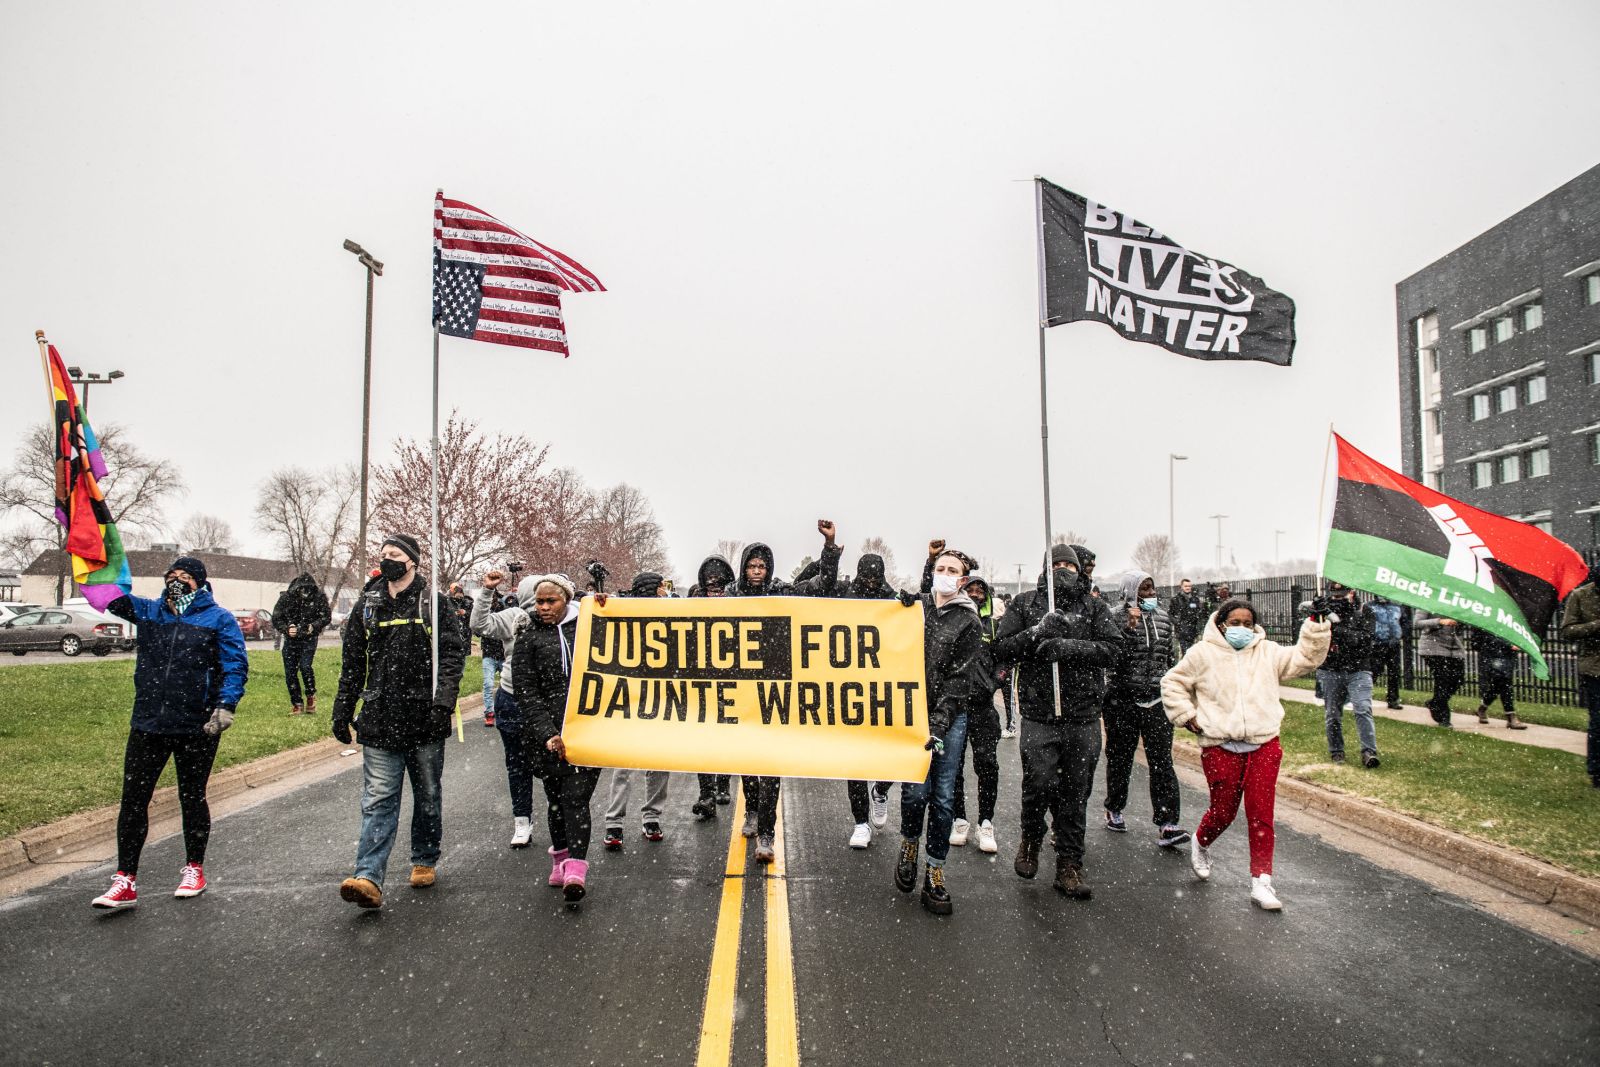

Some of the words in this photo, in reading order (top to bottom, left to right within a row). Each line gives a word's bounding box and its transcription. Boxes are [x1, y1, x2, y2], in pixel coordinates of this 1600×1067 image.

[1087, 237, 1250, 305] LIVES
[1085, 276, 1248, 353] MATTER
[1375, 566, 1433, 599] Black
[1437, 587, 1493, 617] Lives
[590, 621, 764, 670] JUSTICE
[800, 624, 881, 669] FOR
[577, 672, 739, 725] DAUNTE
[757, 681, 920, 727] WRIGHT
